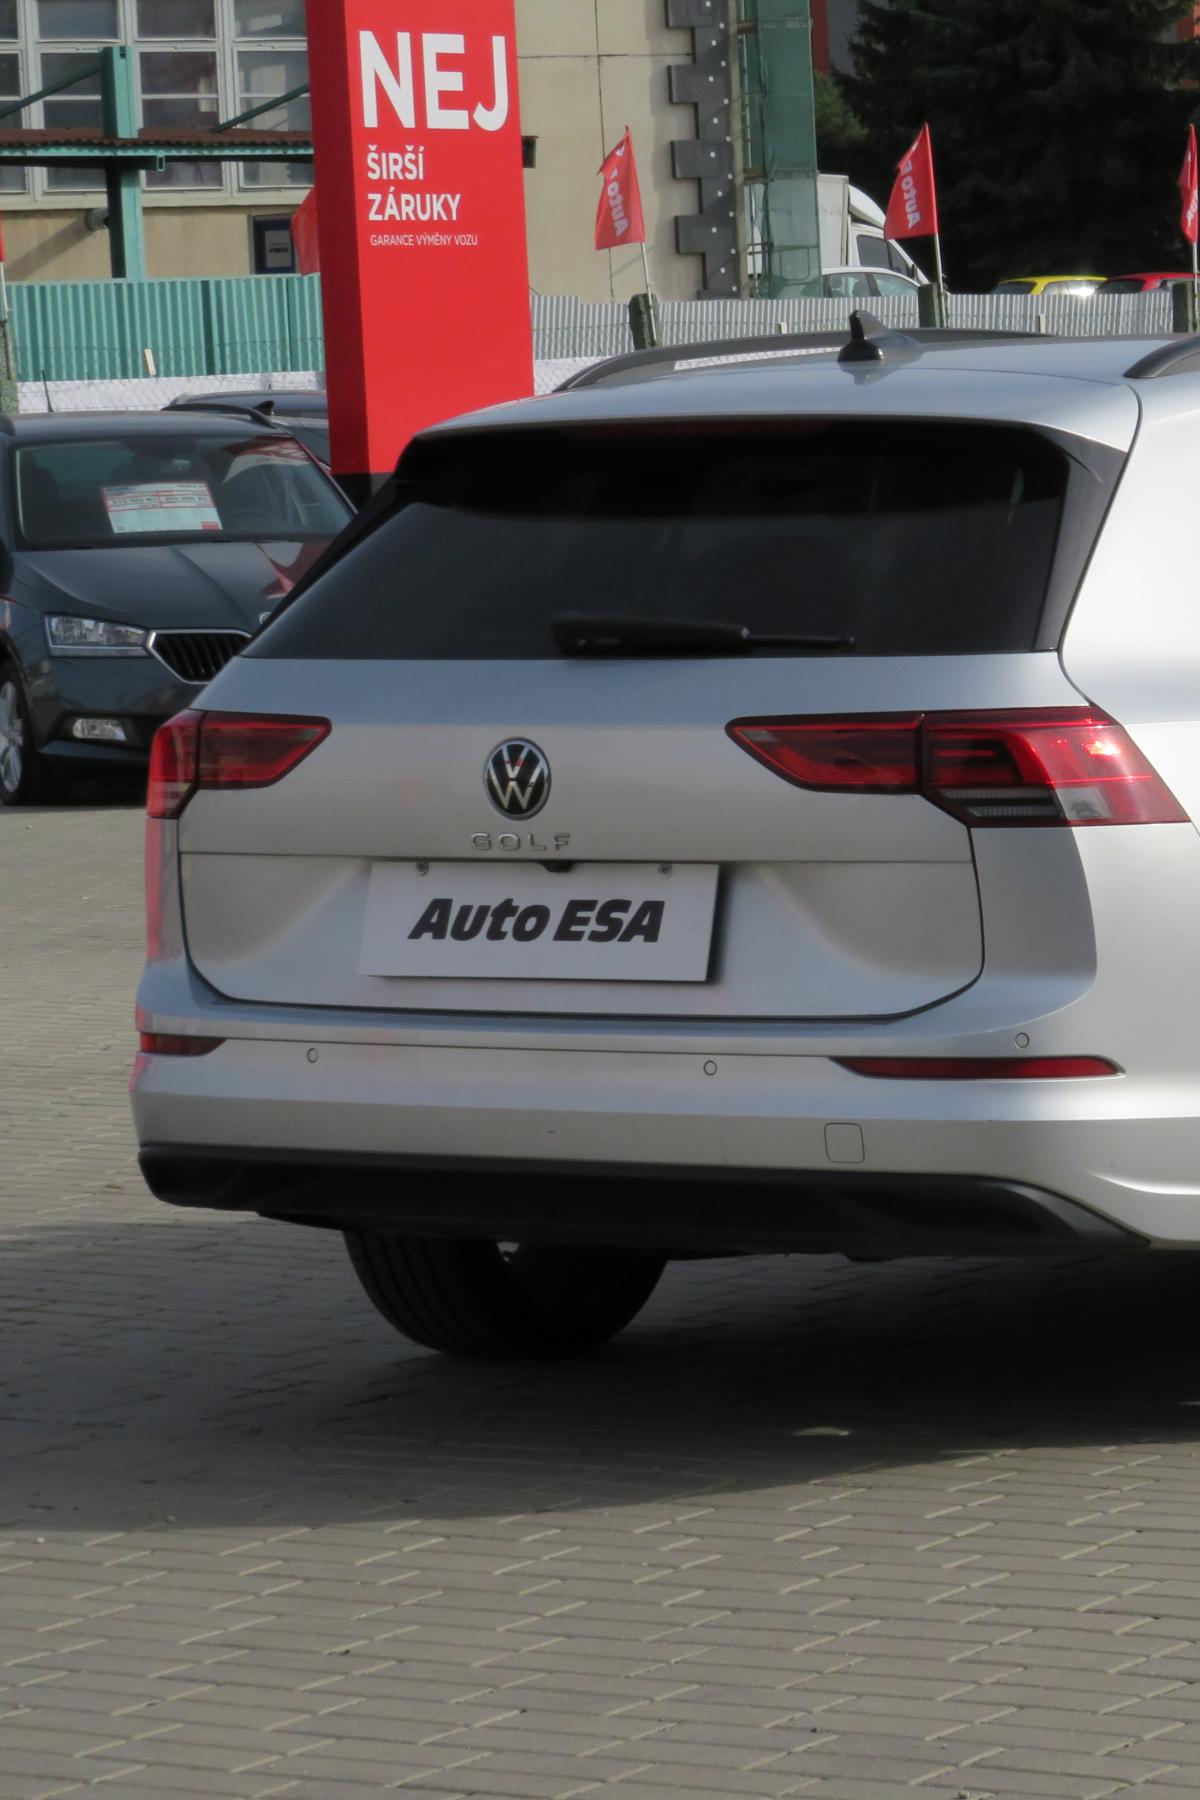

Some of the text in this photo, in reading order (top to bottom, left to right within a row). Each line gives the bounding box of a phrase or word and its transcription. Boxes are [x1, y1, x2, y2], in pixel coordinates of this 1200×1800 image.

[359, 30, 509, 132] NEJ
[366, 144, 425, 180] ŠIRŠÍ
[367, 186, 461, 221] ZÁRUKY
[370, 232, 479, 246] GARANCE VÝMĚNY VOZU
[471, 832, 571, 851] GOLF
[407, 897, 666, 943] Auto ESA
